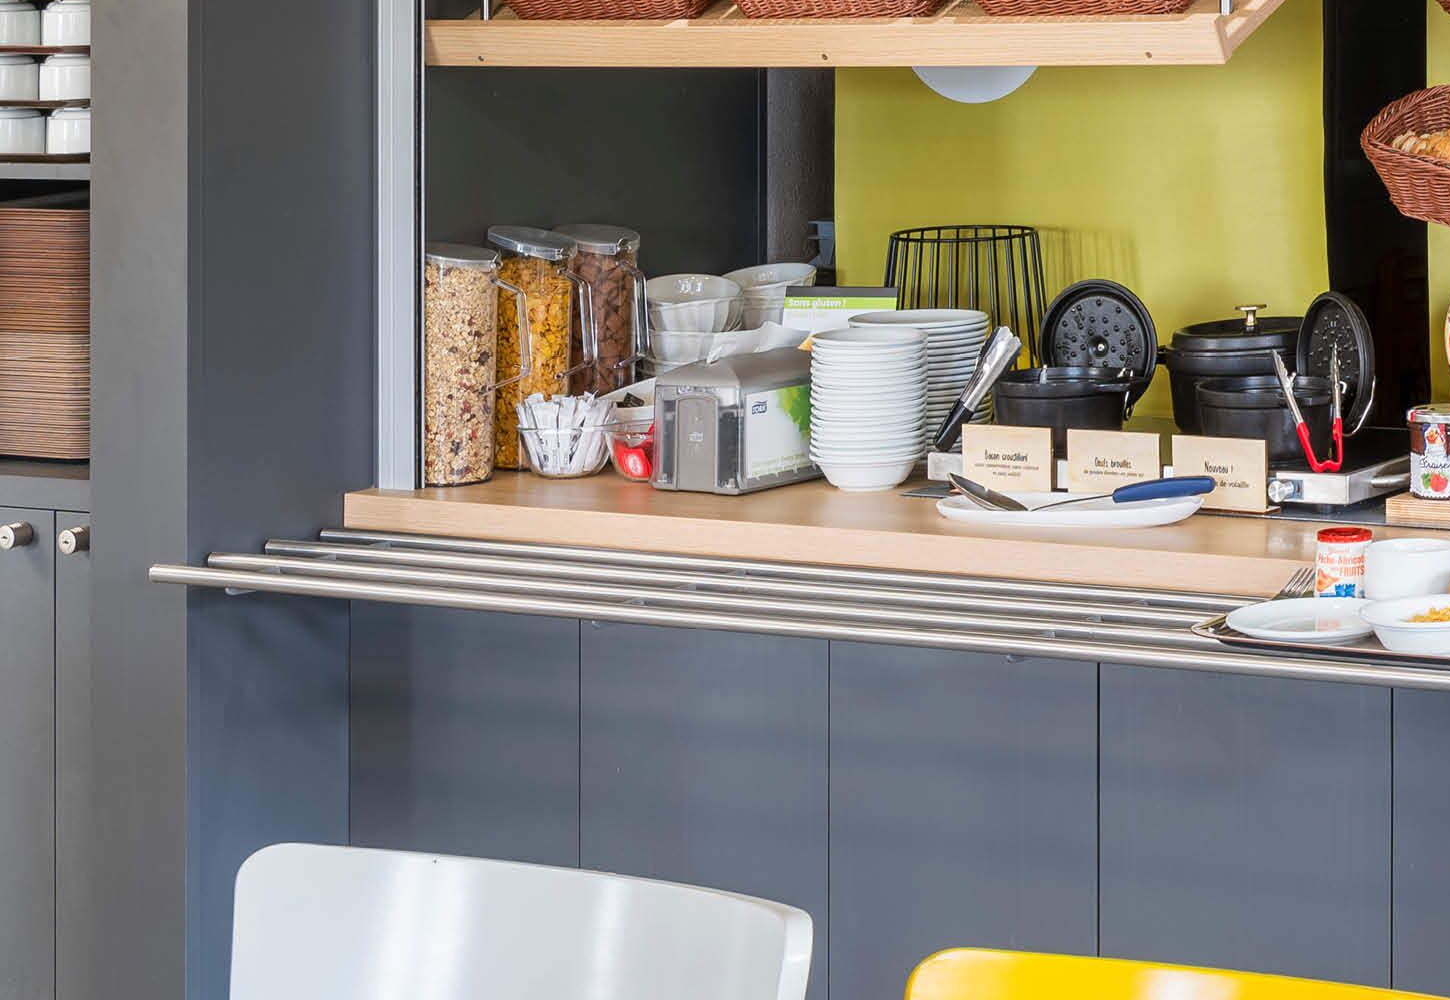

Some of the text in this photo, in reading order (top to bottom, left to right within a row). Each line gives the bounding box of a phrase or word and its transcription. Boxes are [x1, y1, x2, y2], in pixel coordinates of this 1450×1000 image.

[787, 299, 810, 307] Sans
[811, 299, 842, 309] gluten
[1204, 460, 1229, 474] Nouveau
